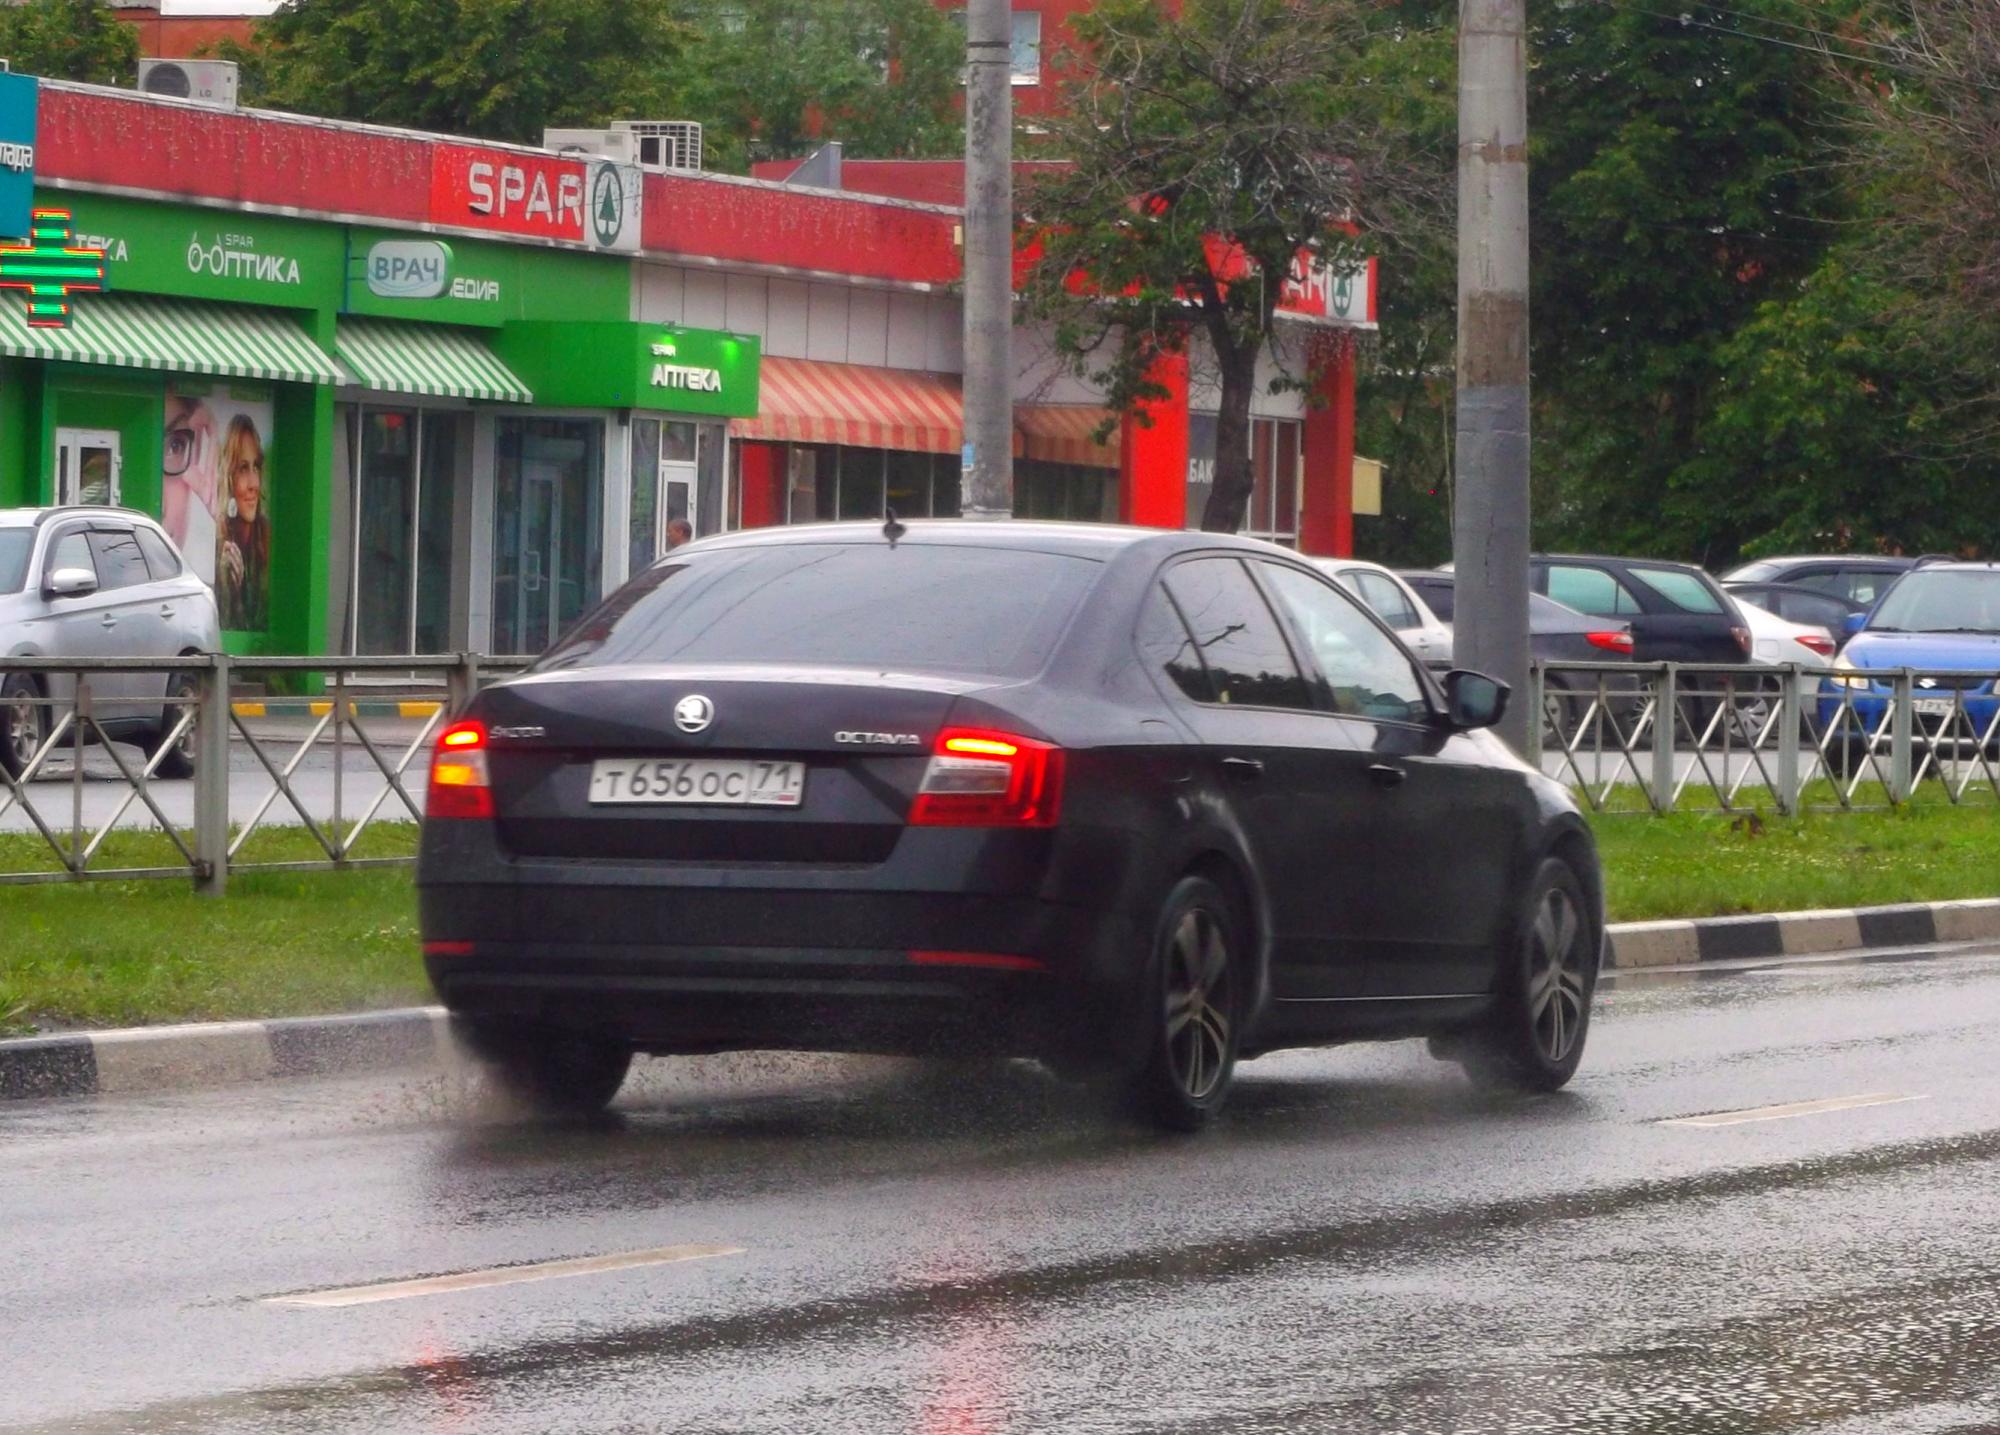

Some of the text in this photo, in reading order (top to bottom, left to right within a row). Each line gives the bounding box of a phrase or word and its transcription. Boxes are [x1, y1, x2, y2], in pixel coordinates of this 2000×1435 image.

[468, 162, 583, 227] SPAR
[225, 233, 254, 248] SPAR
[208, 243, 300, 284] ОПТИКА
[375, 257, 439, 282] ВРАЧ
[651, 364, 721, 392] АПТЕКА
